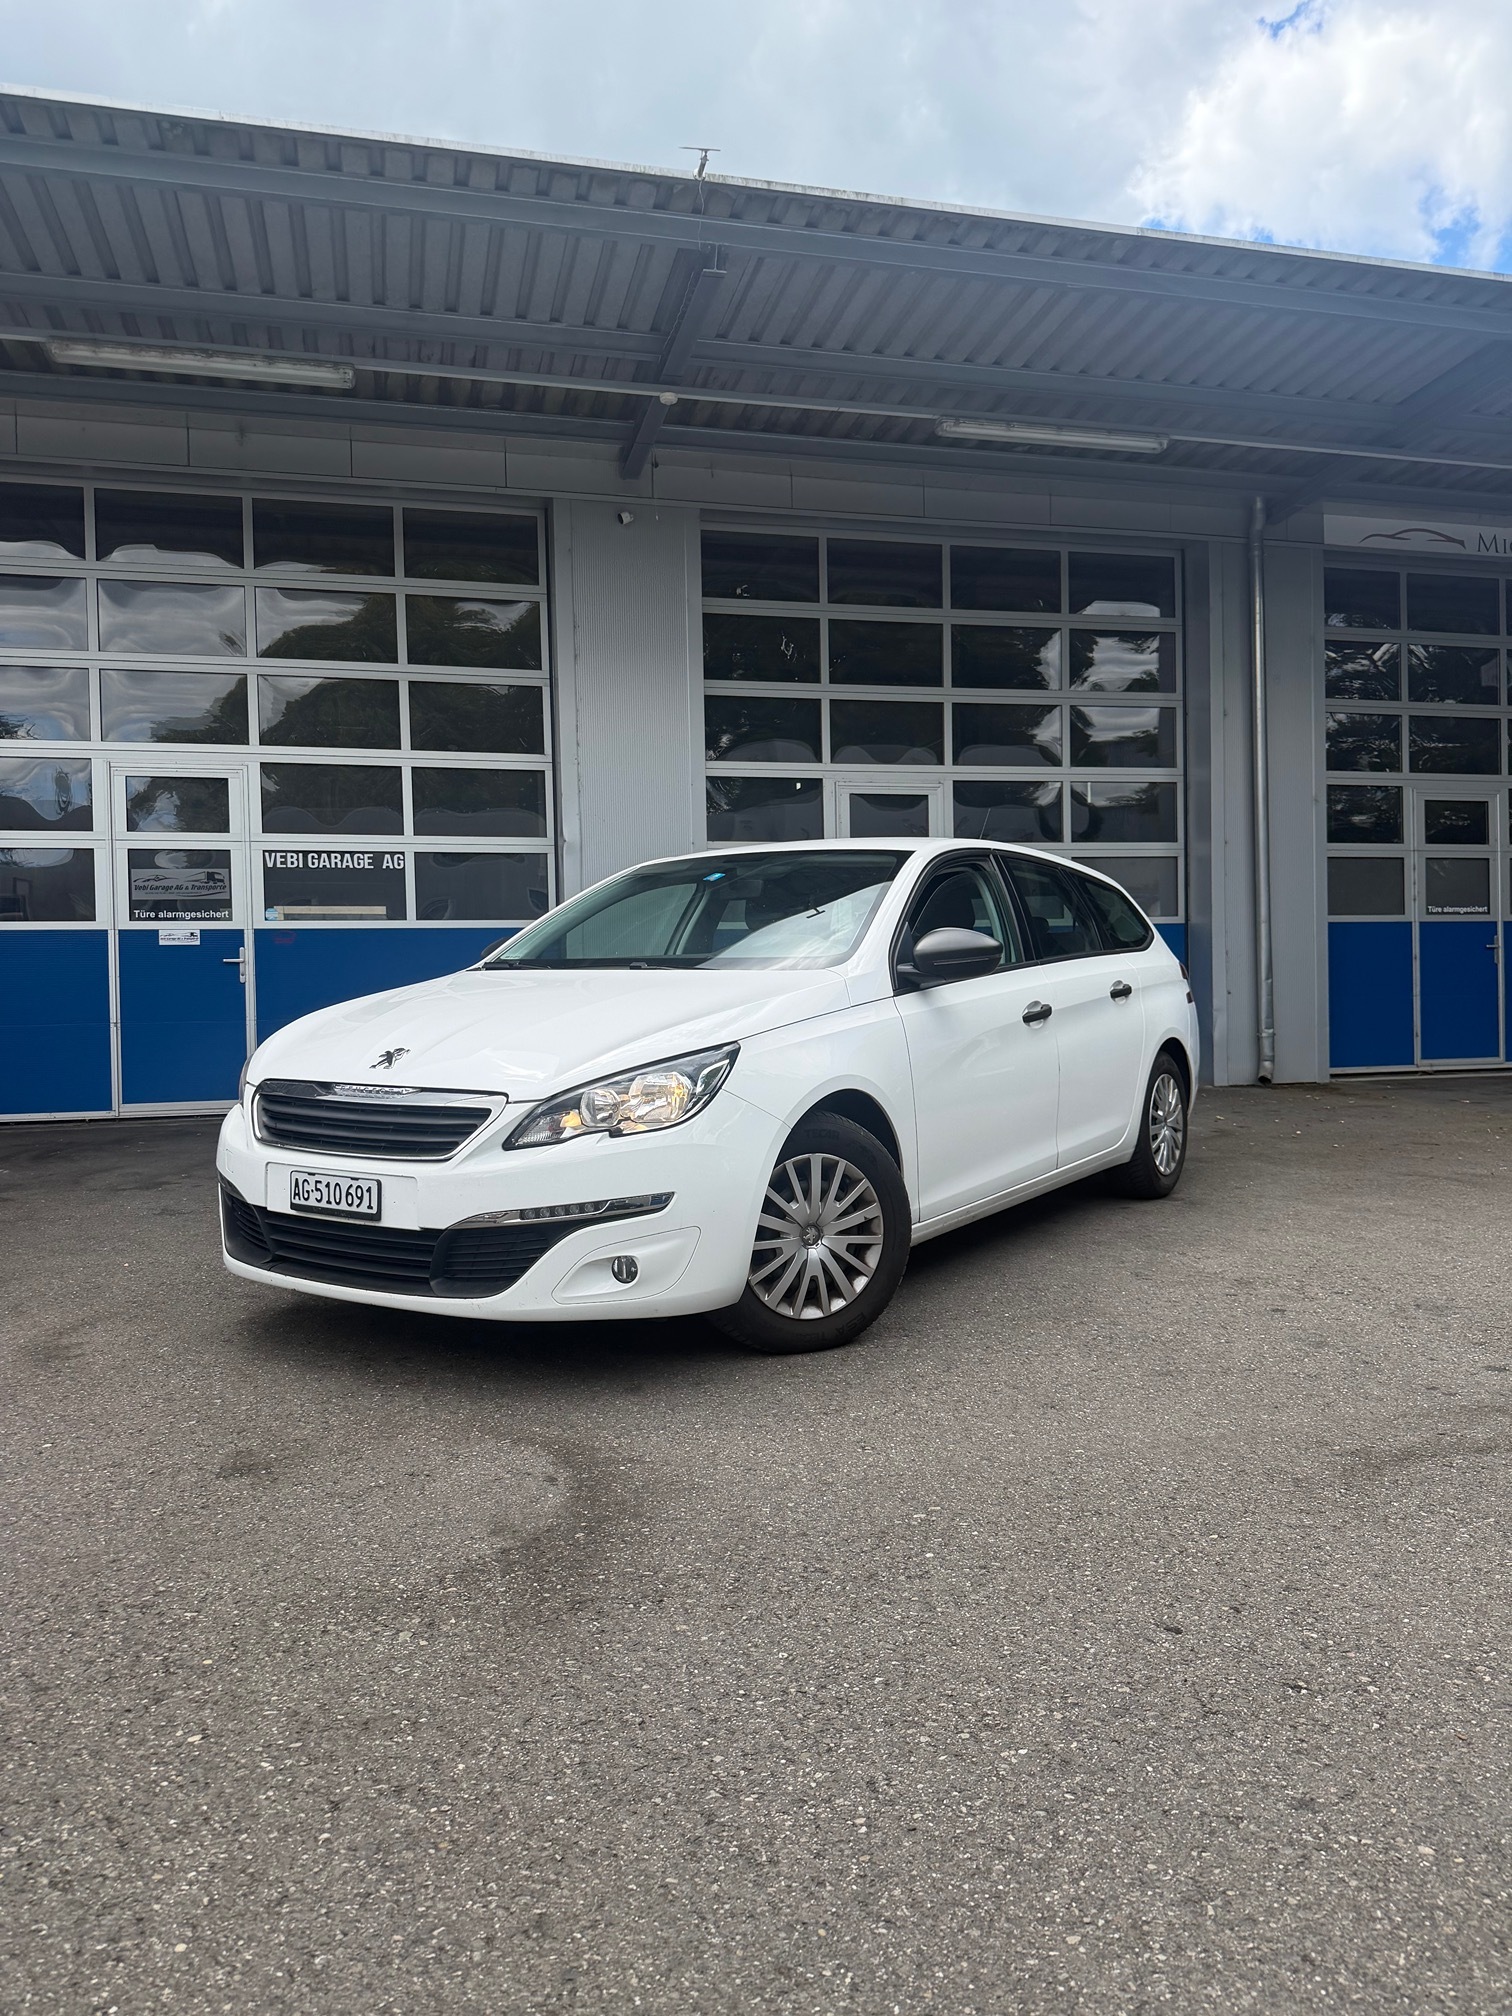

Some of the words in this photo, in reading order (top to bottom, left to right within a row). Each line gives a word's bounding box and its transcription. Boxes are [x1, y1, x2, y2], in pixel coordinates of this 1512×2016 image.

[1477, 532, 1512, 554] MI
[264, 852, 304, 868] VEBI
[307, 852, 374, 869] GARAGE
[382, 853, 405, 869] AG
[133, 909, 156, 918] Türe
[158, 909, 229, 919] alarmgesichert
[1428, 905, 1442, 913] Türe
[1443, 905, 1488, 914] alarmgesichert
